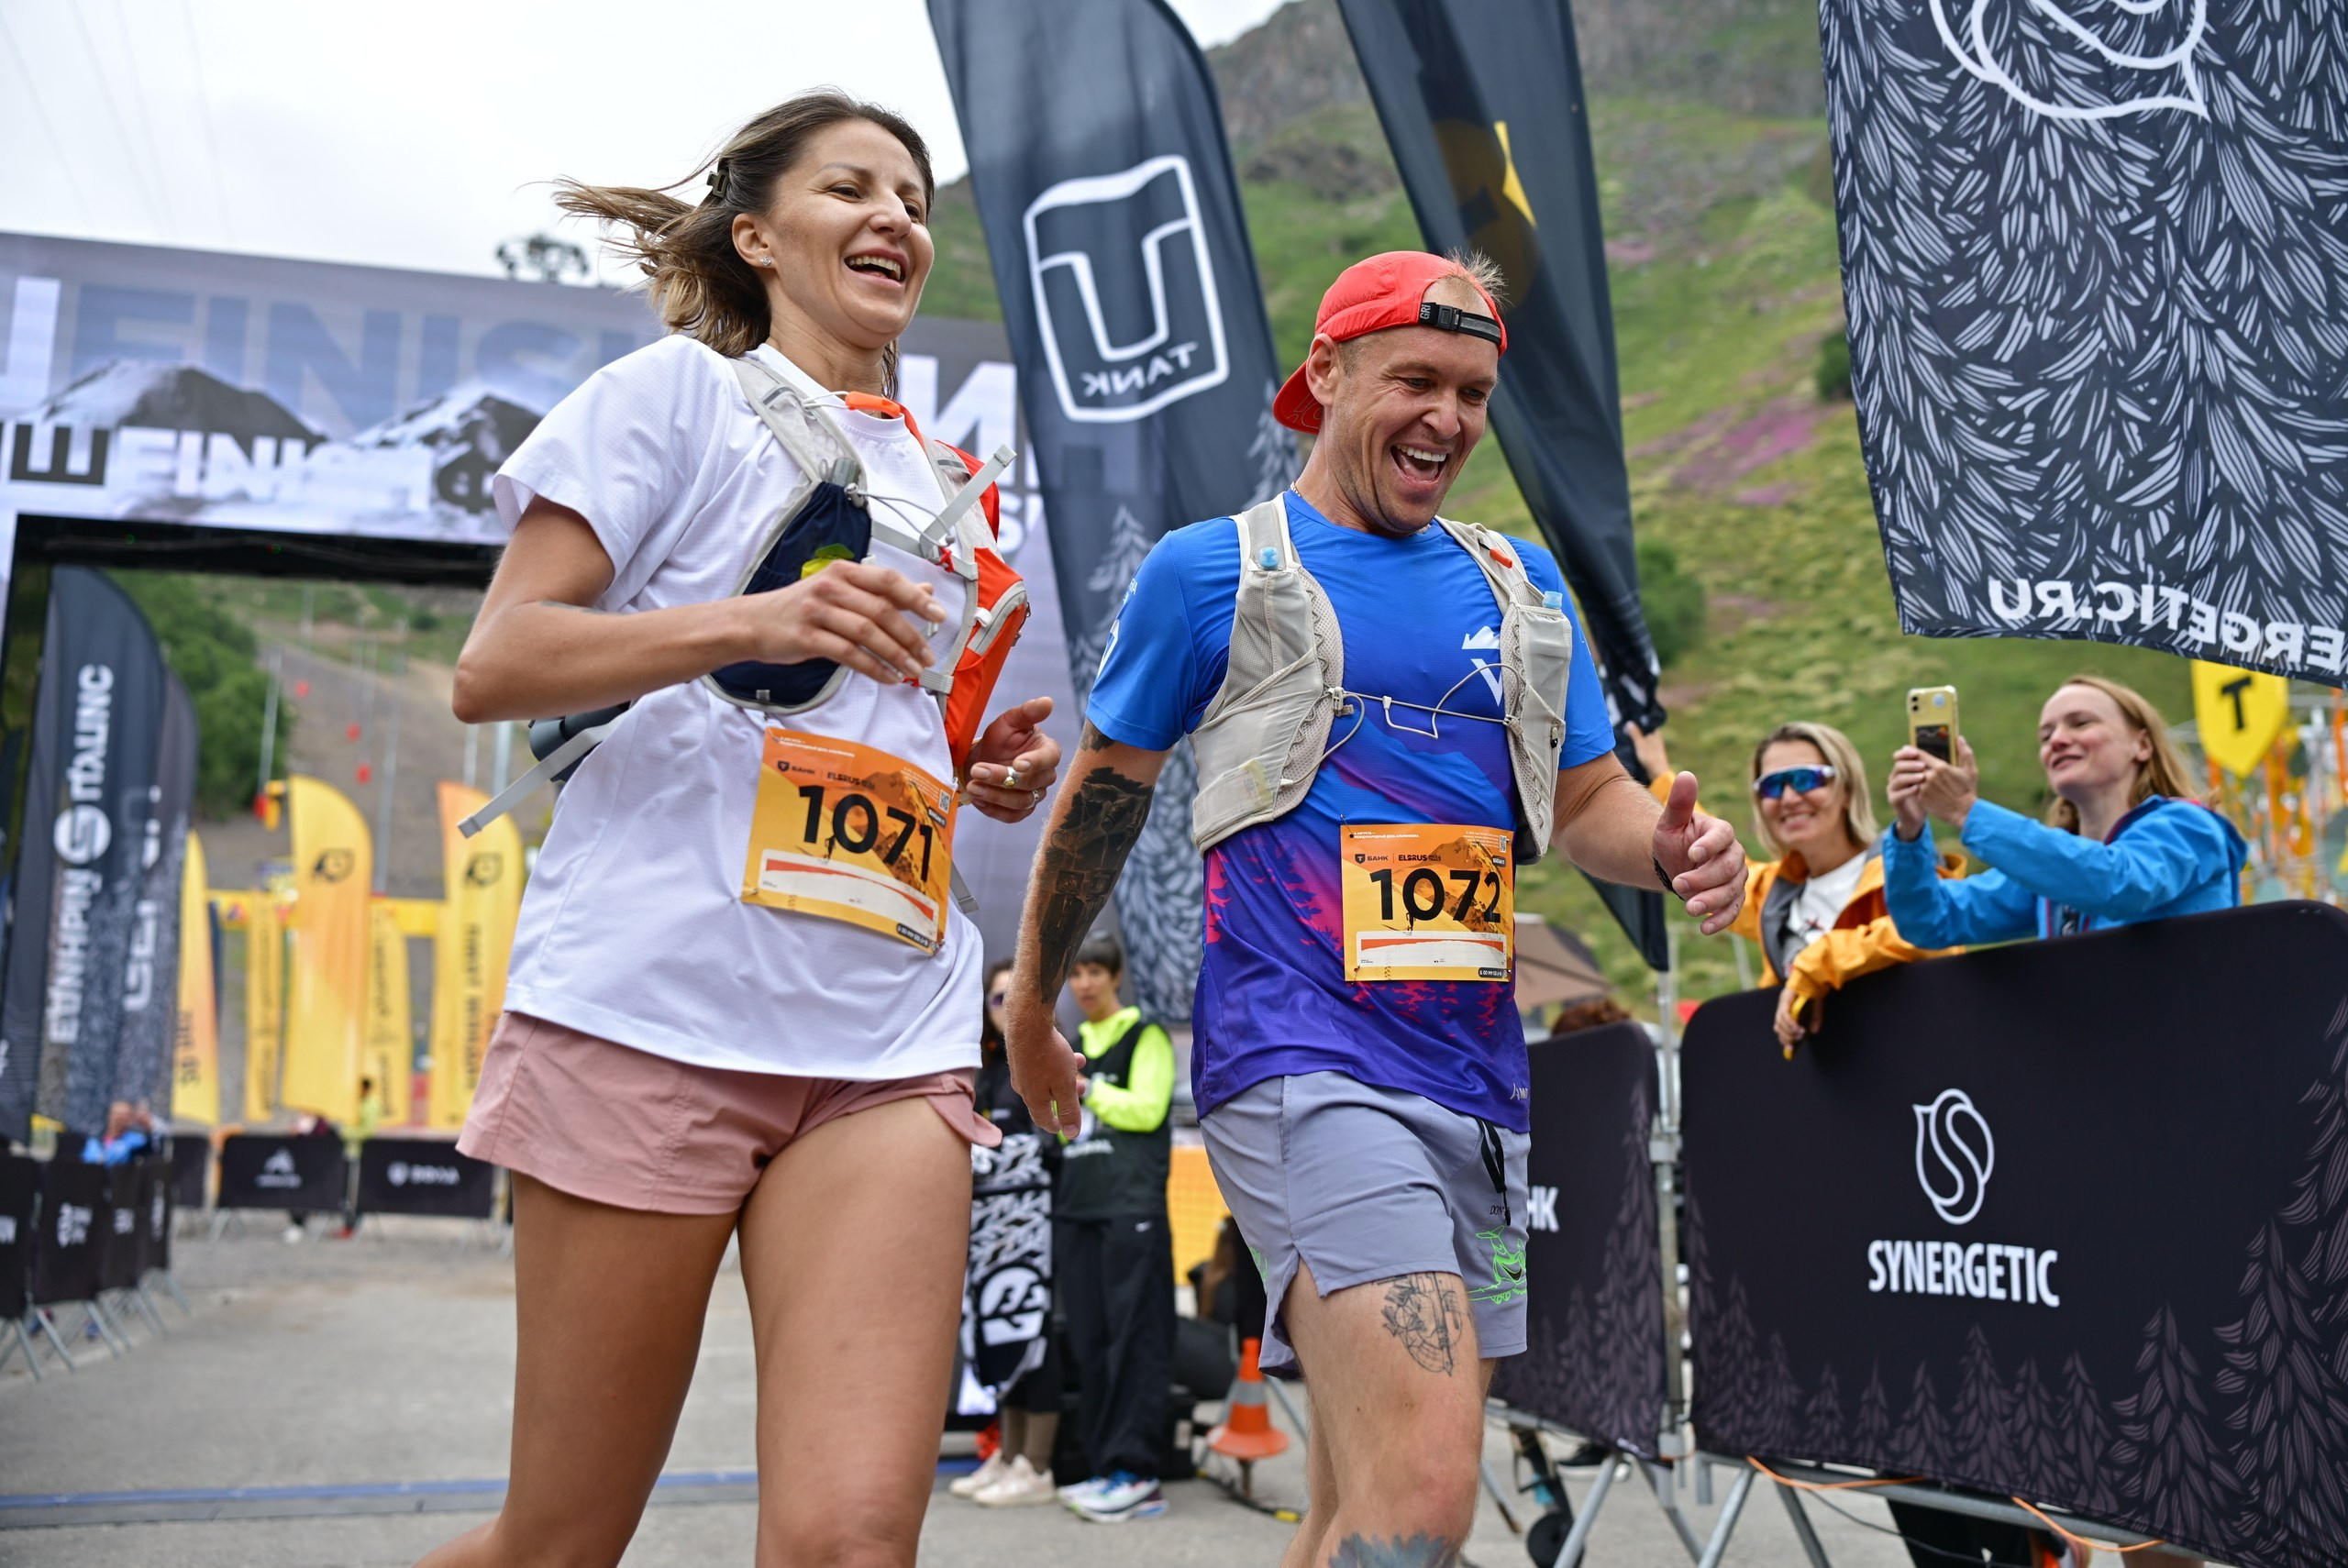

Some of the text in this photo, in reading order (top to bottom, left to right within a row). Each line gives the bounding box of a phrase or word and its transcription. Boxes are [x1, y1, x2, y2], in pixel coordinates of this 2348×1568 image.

[799, 785, 933, 882] 1071
[1369, 868, 1501, 923] 1072
[1867, 1239, 2060, 1308] SYNERGETIC
